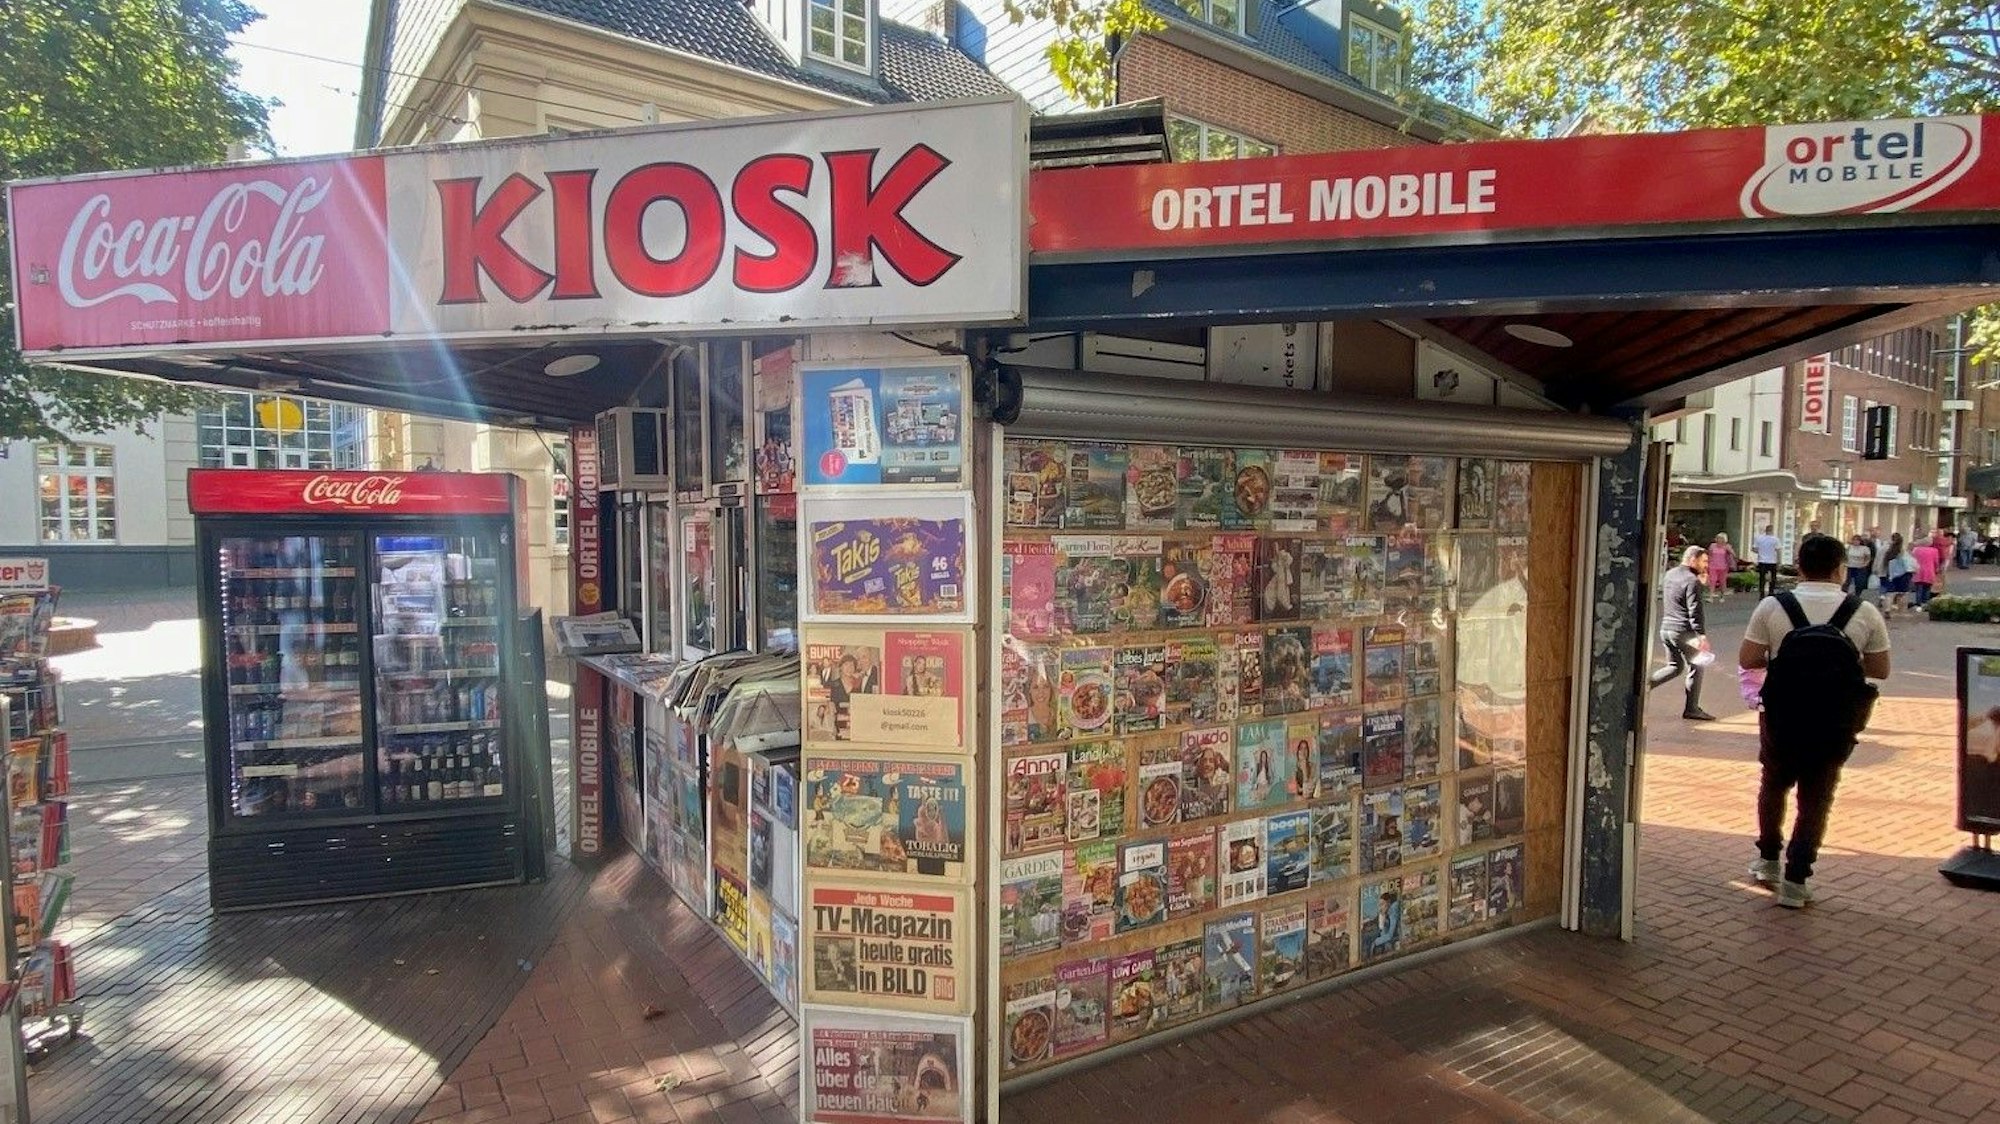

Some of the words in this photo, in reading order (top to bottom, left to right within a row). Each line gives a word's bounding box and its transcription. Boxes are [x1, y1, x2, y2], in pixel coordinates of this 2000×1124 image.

[1786, 122, 1924, 165] ortel
[1789, 162, 1923, 184] MOBILE
[1151, 182, 1294, 231] ORTEL
[1309, 168, 1497, 222] MOBILE
[434, 142, 962, 305] KIOSK
[58, 176, 332, 308] Coca-Cola
[577, 430, 597, 508] MOBILE
[302, 474, 408, 507] Coca-Cola
[580, 514, 598, 579] ORTEL
[831, 535, 882, 582] Takis
[932, 556, 949, 571] 46
[810, 645, 841, 660] BUNTE
[881, 721, 929, 733] @gmail.com
[579, 707, 599, 786] MOBILE
[1014, 757, 1061, 775] Anna
[907, 785, 942, 801] TASTE
[943, 788, 960, 801] IT!
[580, 790, 598, 854] ORTEL
[1004, 858, 1061, 880] GARDEN
[854, 892, 877, 907] Jede
[880, 894, 914, 908] Woche
[814, 905, 953, 940] TV-Magazin
[859, 938, 904, 963] heute
[907, 943, 953, 967] gratis
[859, 965, 878, 993] in
[882, 966, 928, 996] BILD
[1112, 963, 1131, 979] LOW
[816, 1047, 851, 1067] Alles
[816, 1072, 850, 1089] über
[853, 1070, 877, 1089] die
[816, 1094, 863, 1111] neuen
